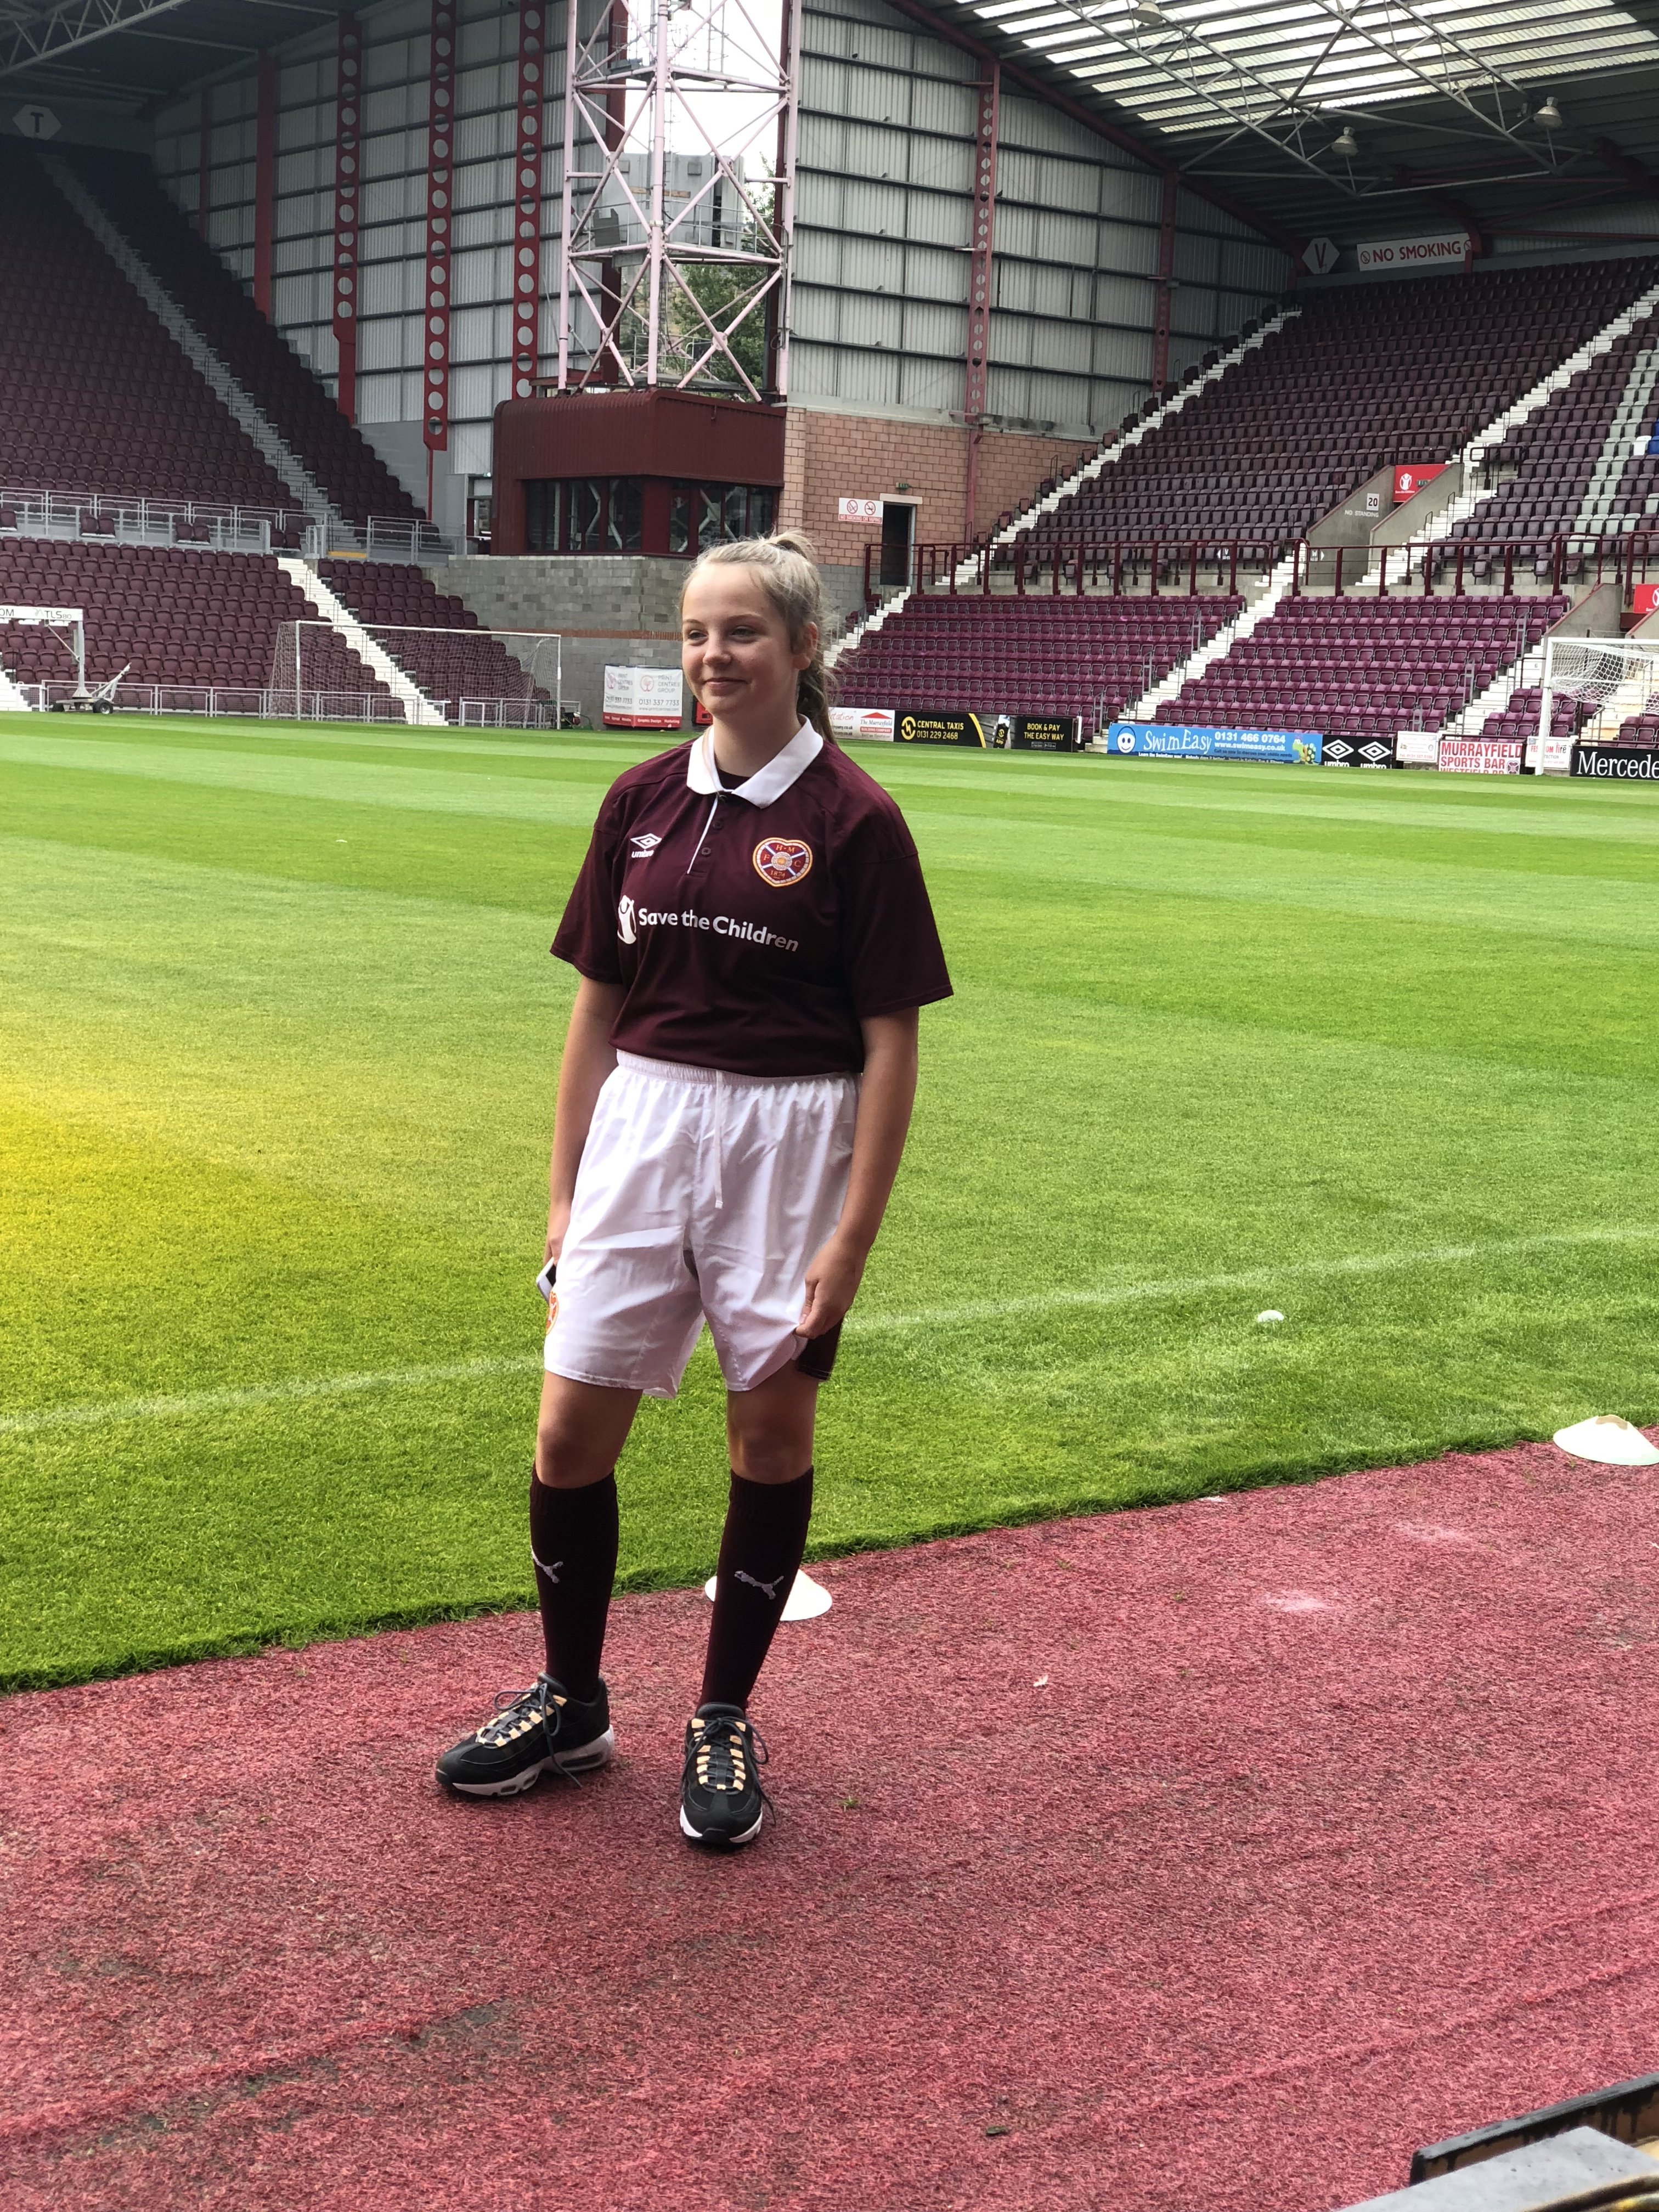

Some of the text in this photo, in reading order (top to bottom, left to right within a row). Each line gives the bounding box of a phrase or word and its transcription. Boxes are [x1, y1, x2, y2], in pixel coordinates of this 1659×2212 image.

[30, 112, 44, 133] T
[1314, 242, 1327, 268] V
[1373, 240, 1461, 263] NO SMOKING
[1368, 497, 1378, 506] 20
[917, 720, 964, 730] CENTRAL TAXIS
[943, 731, 958, 740] 2468
[1024, 731, 1034, 740] THE
[1215, 731, 1286, 744] 0131 466 0764
[1215, 741, 1286, 751] www.swimeasy.co.uk
[1441, 742, 1522, 758] MURRAYFIELD
[1441, 756, 1505, 769] SPORTS BAR
[770, 870, 786, 878] 1874
[638, 908, 799, 952] Save the Children
